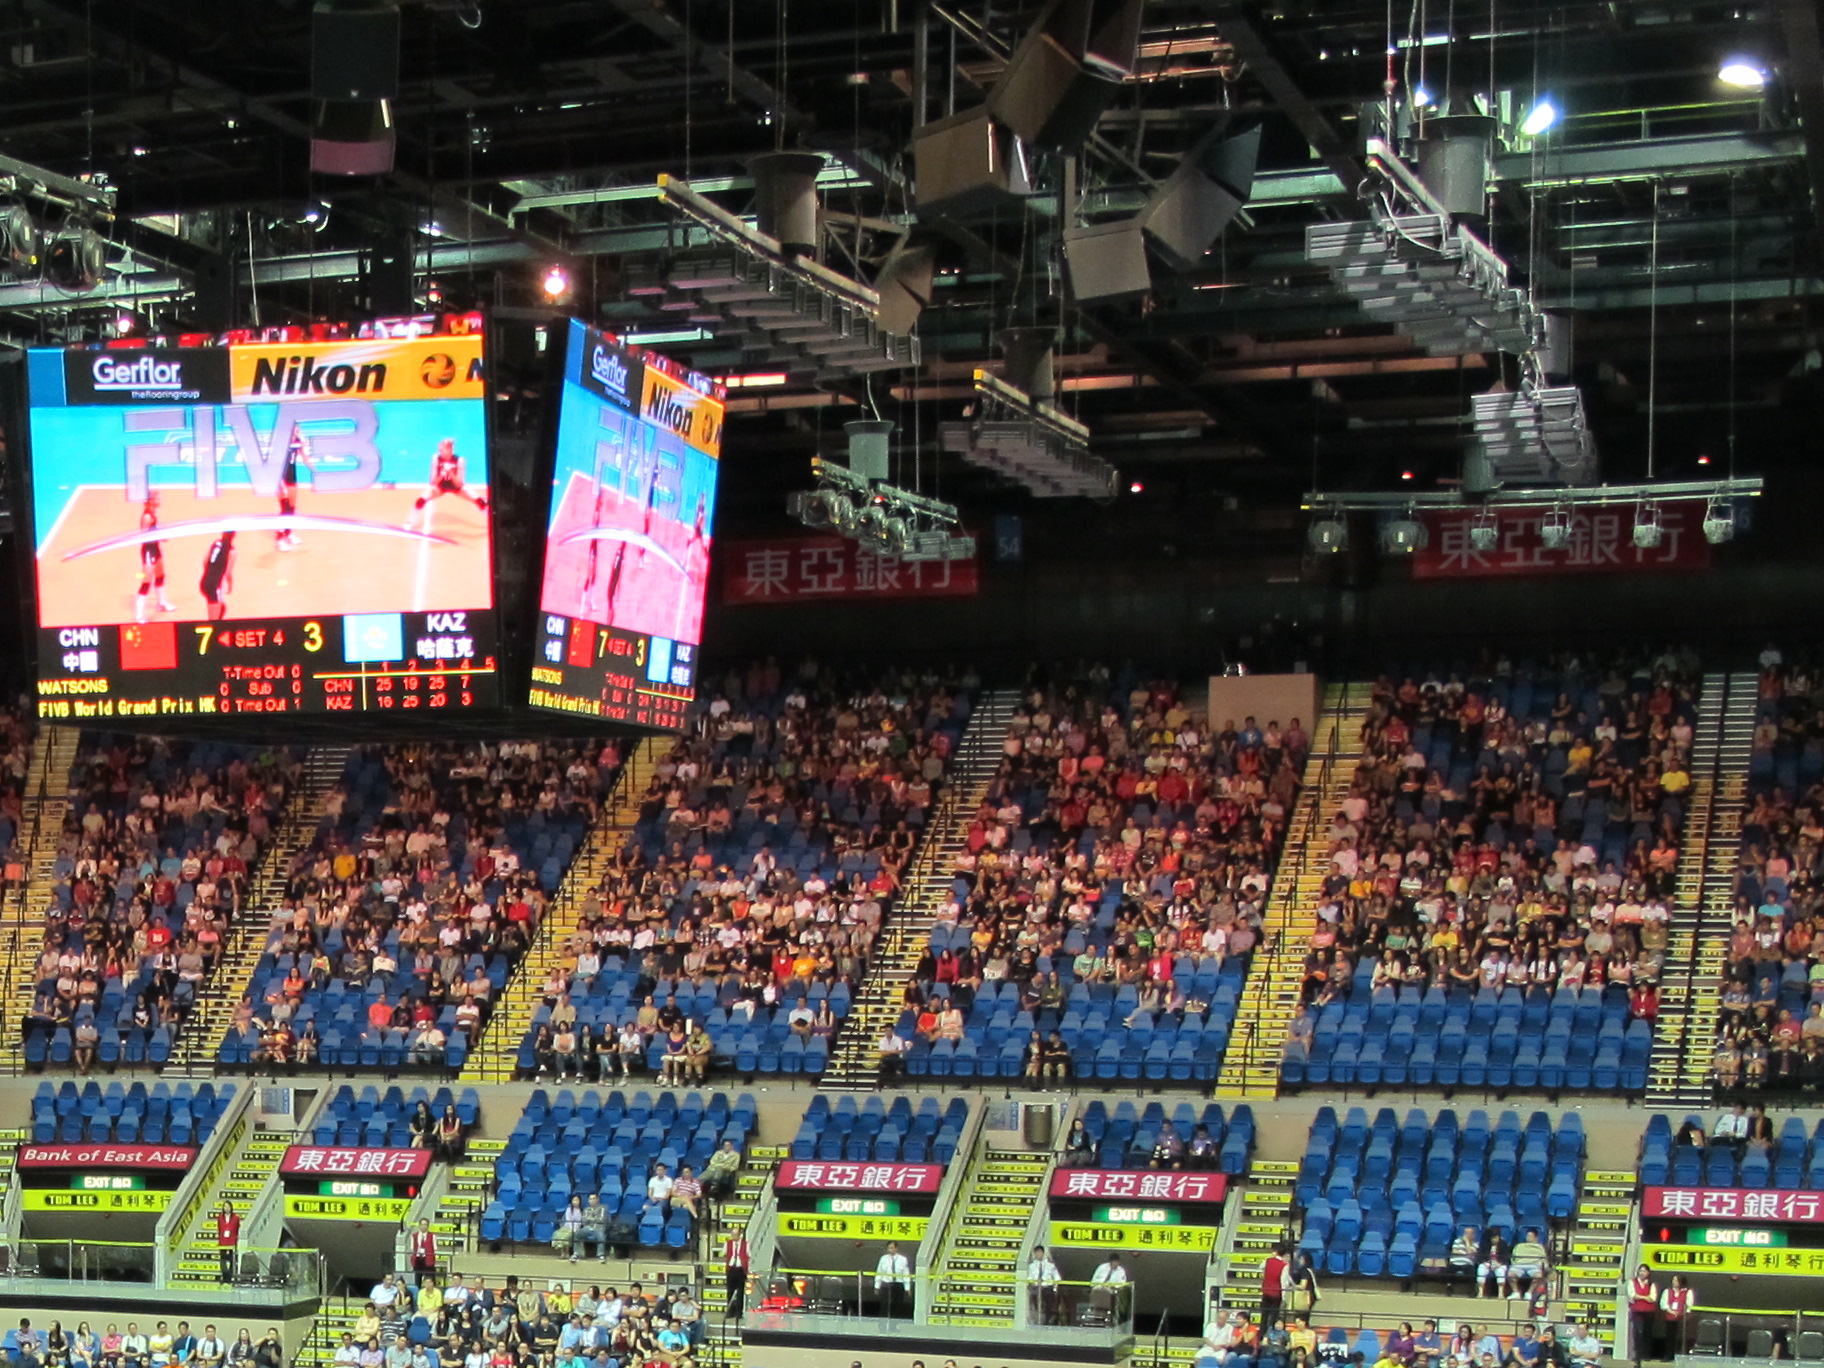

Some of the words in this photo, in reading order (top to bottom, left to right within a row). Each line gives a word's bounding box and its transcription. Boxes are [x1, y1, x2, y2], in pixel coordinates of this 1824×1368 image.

[93, 357, 182, 384] Gerflor
[592, 345, 629, 388] Gerflor
[252, 355, 387, 396] Nikon
[648, 381, 694, 436] Nikon
[124, 400, 382, 501] FIVB
[59, 629, 98, 648] CHN
[195, 626, 213, 655] 7
[234, 631, 267, 647] SET
[273, 631, 284, 646] 4
[303, 622, 323, 652] 3
[427, 613, 466, 633] KAZ
[416, 638, 473, 659] 哈薩克
[597, 630, 610, 658] 7
[635, 638, 647, 667] 3
[63, 651, 98, 672] 中國
[265, 666, 286, 679] Out
[38, 680, 108, 695] WATSONS
[249, 682, 272, 696] Sub
[325, 680, 354, 692] CHN
[376, 678, 392, 691] 25
[403, 677, 419, 690] 19
[429, 676, 446, 690] 25
[460, 675, 470, 687] 7
[39, 701, 69, 717] FIVB
[75, 700, 113, 716] World
[118, 699, 157, 716] Grand
[162, 698, 193, 715] Prix
[199, 697, 217, 713] HK
[236, 699, 263, 712] Time
[265, 698, 286, 712] Out
[325, 696, 354, 710] KAZ
[402, 694, 419, 708] 25
[429, 693, 447, 707] 20
[461, 693, 472, 706] 3
[24, 1149, 72, 1163] Bank
[77, 1149, 100, 1163] of
[104, 1149, 142, 1164] East
[146, 1149, 188, 1164] Asia
[294, 1149, 416, 1174] 東亞銀行
[83, 1175, 110, 1189] EXIT
[791, 1163, 928, 1190] 東亞銀行
[332, 1182, 358, 1195] EXIT
[1066, 1172, 1209, 1200] 東亞銀行
[47, 1194, 72, 1206] TOM
[75, 1194, 96, 1206] LEE
[295, 1201, 318, 1213] TOM
[323, 1201, 345, 1214] LEE
[831, 1199, 860, 1213] EXIT
[1660, 1190, 1820, 1220] 東亞銀行
[1108, 1208, 1139, 1222] EXIT
[792, 1219, 816, 1231] TOM
[822, 1219, 845, 1232] LEE
[1065, 1228, 1093, 1241] TOM
[1097, 1229, 1121, 1242] LEE
[1706, 1229, 1741, 1244] EXIT
[1657, 1251, 1689, 1264] TOM
[1694, 1251, 1720, 1266] LEE
